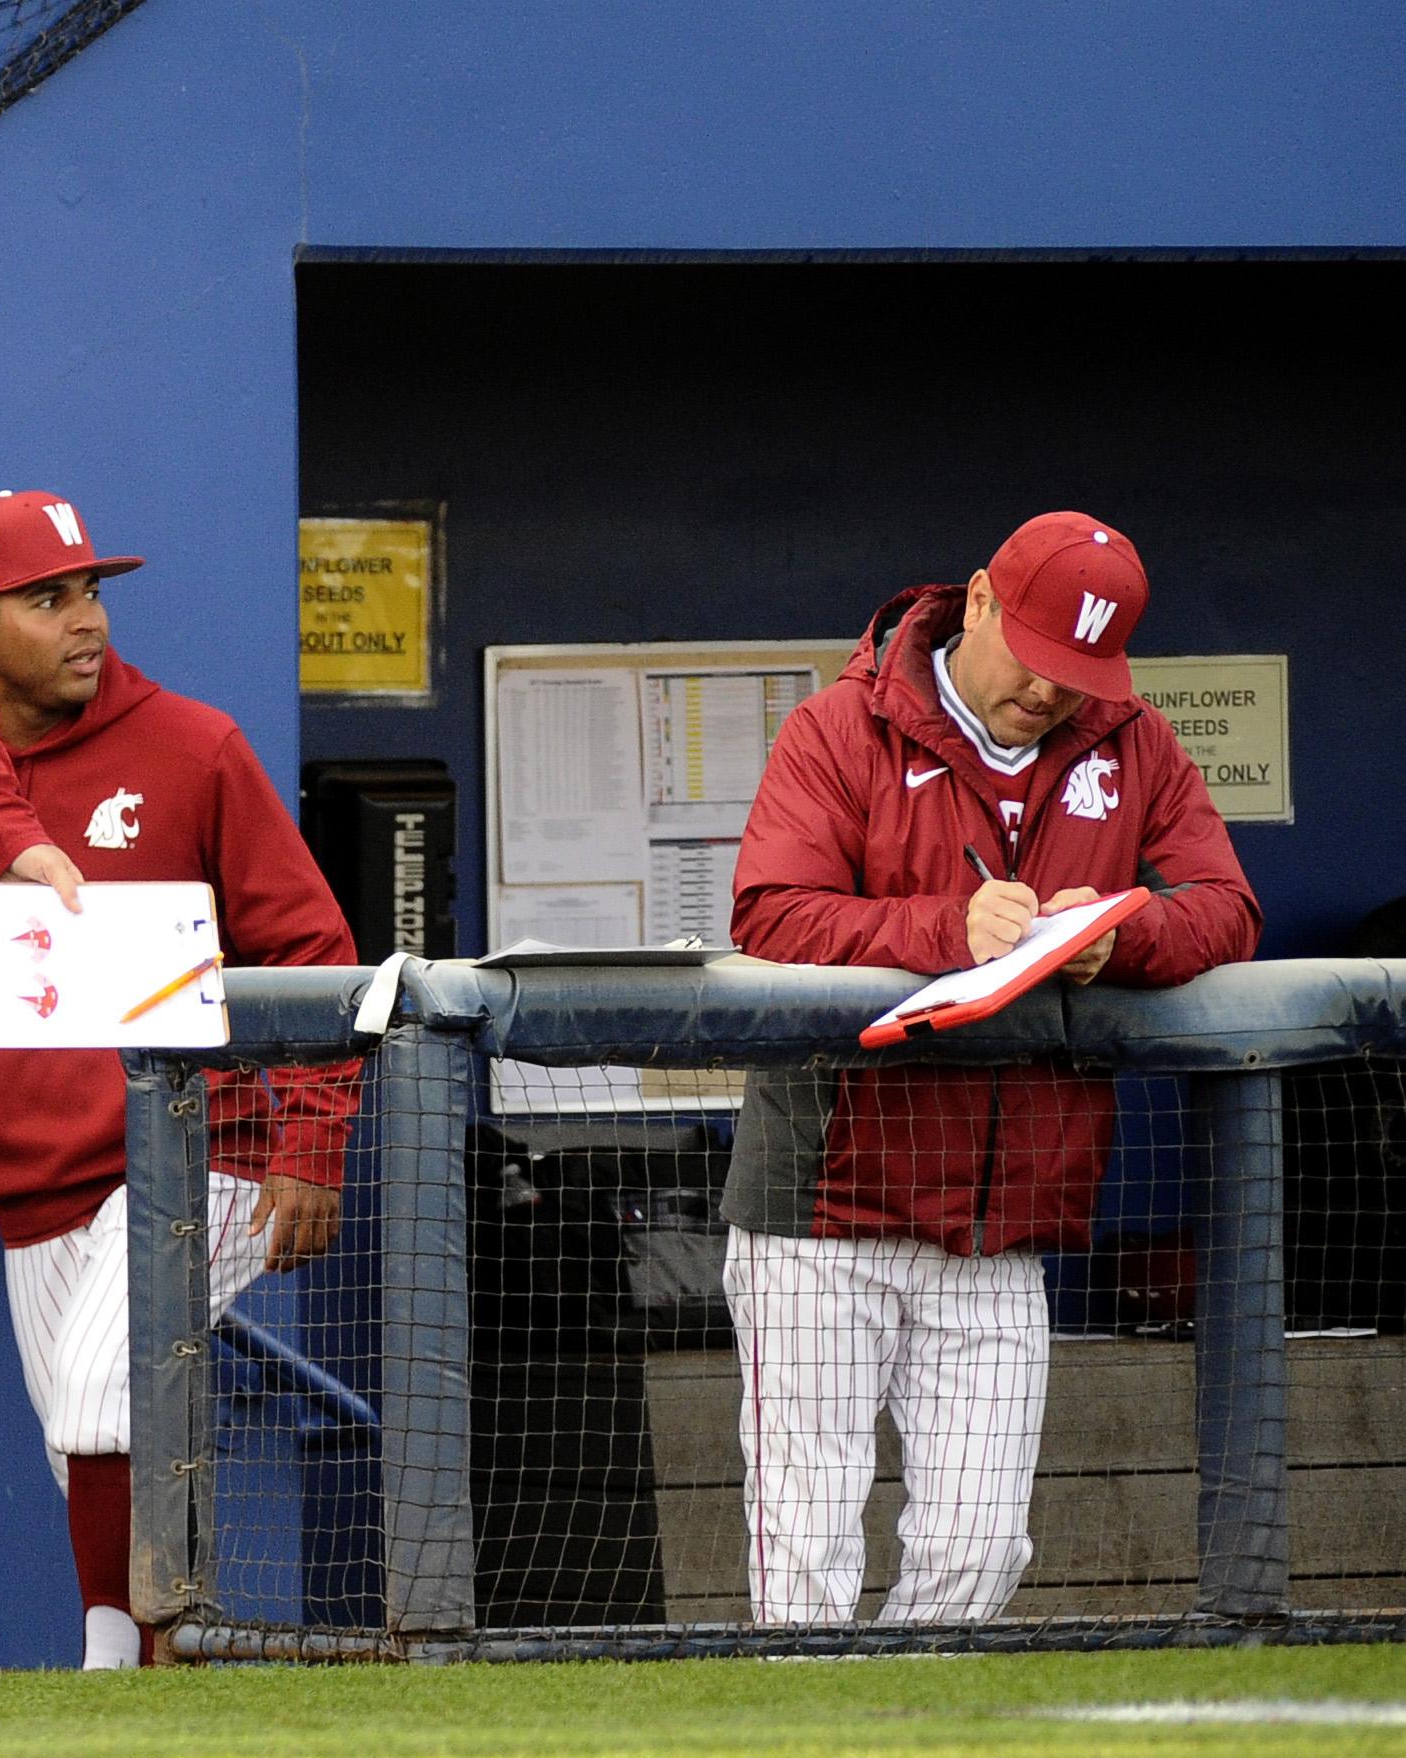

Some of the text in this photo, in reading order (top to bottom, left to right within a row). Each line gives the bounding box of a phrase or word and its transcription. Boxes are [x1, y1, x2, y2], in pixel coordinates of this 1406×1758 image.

[42, 502, 83, 546] W
[300, 557, 393, 574] NFLOWER
[303, 585, 365, 602] SEEDS
[1074, 590, 1118, 644] W
[353, 631, 406, 650] ONLY
[1140, 690, 1256, 708] SUNFLOWER
[1170, 719, 1229, 736] SEEDS
[1196, 745, 1217, 756] THE
[1217, 763, 1270, 783] ONLY
